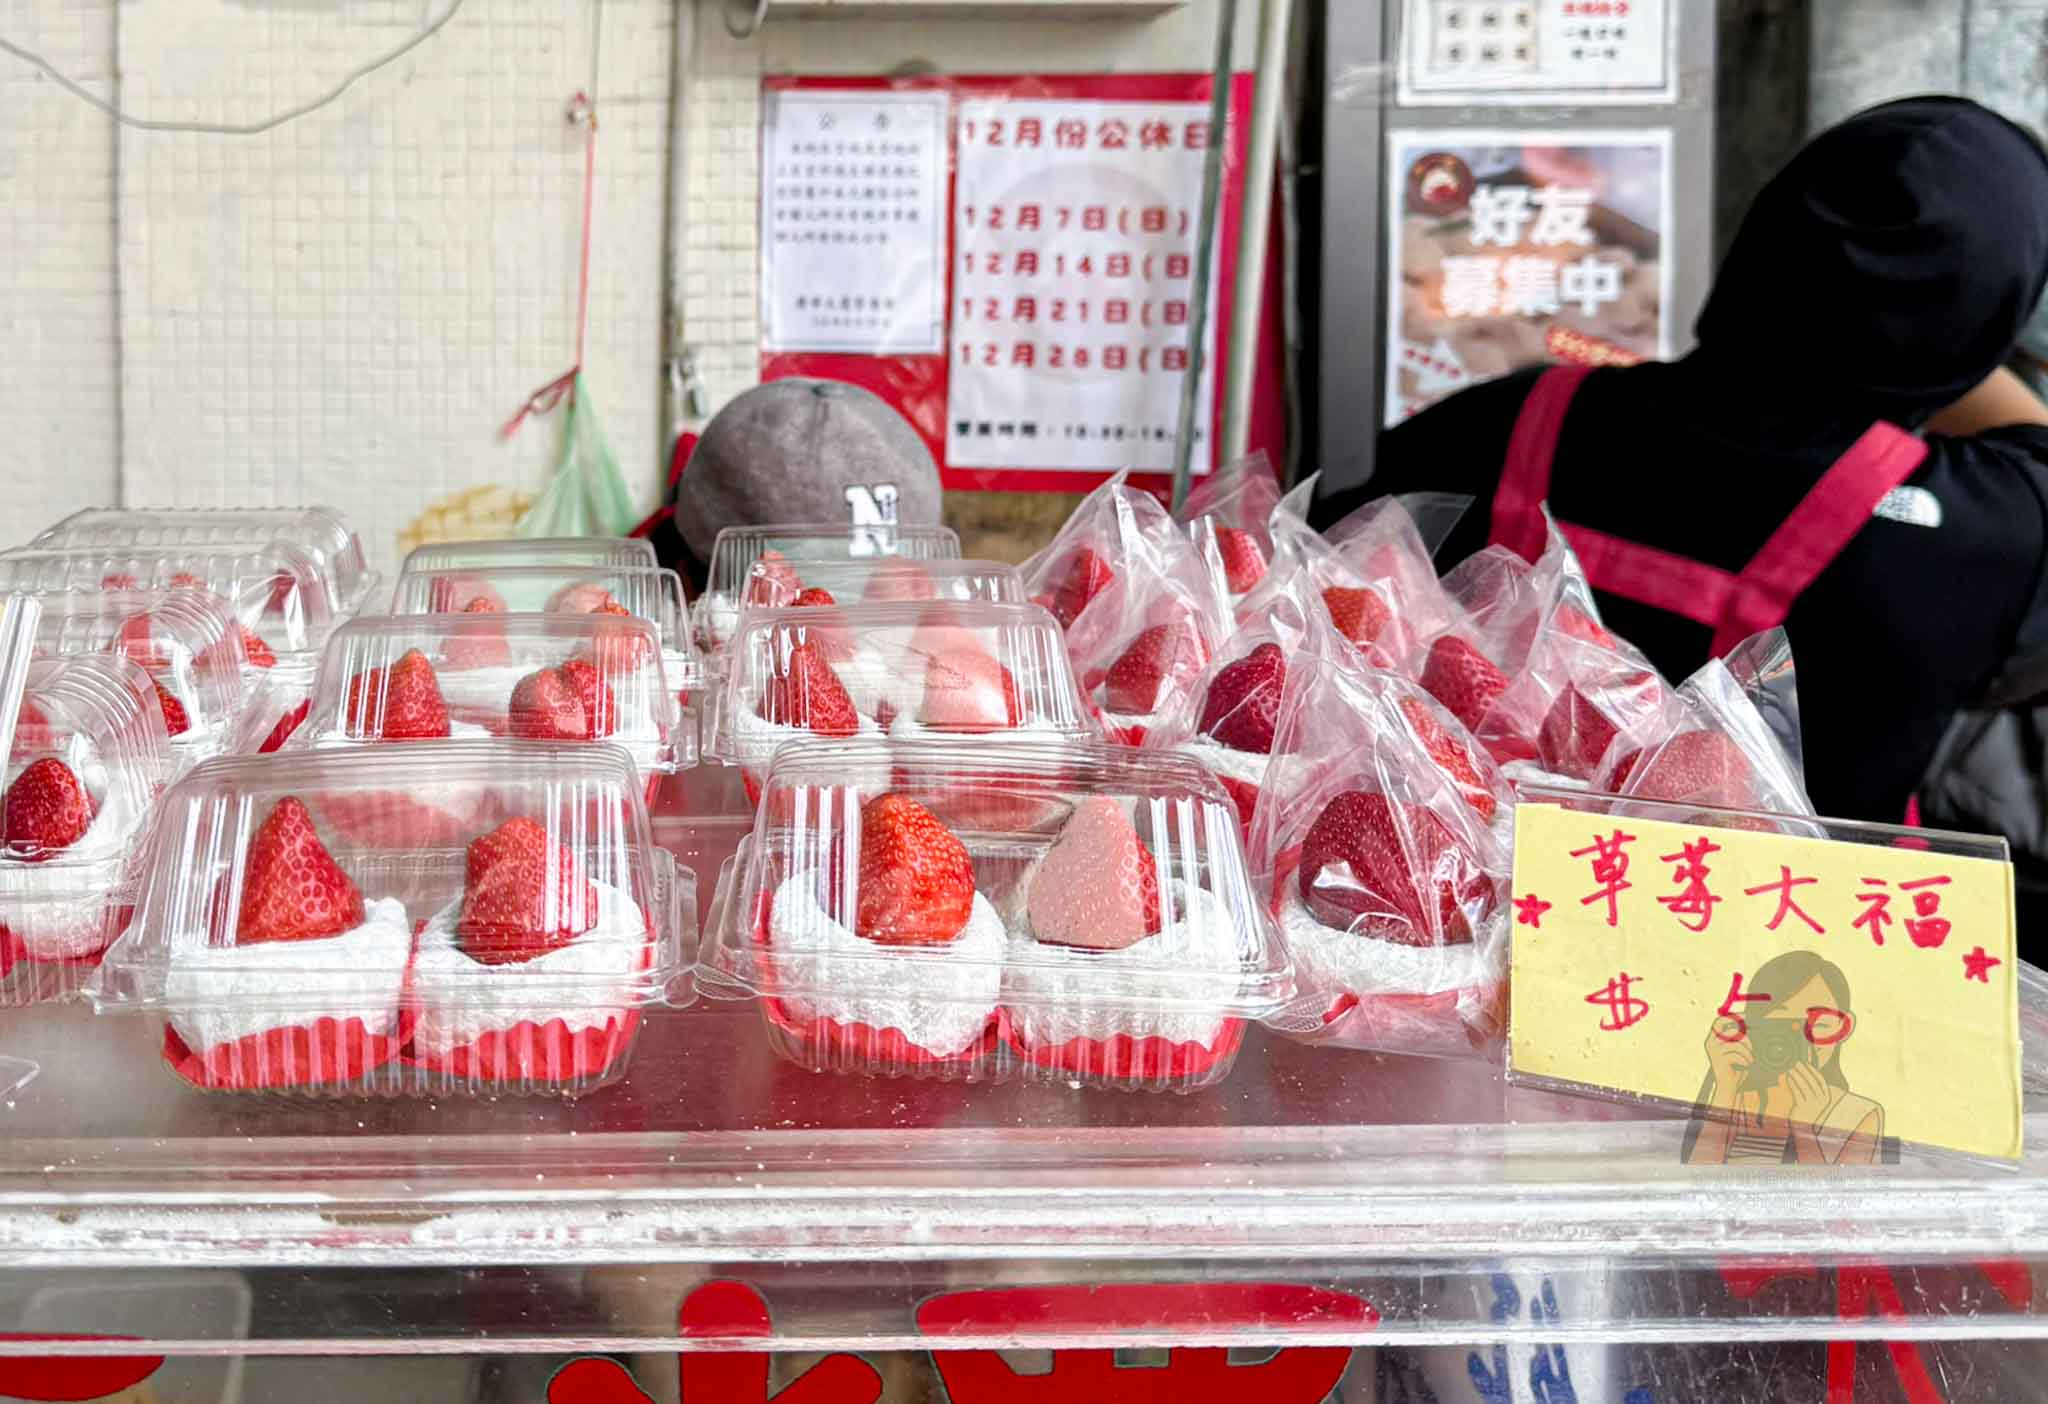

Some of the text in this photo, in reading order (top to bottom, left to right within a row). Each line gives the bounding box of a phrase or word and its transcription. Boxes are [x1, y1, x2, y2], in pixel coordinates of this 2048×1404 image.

[965, 117, 1211, 149] 12月份公休日
[1470, 185, 1596, 246] 好友
[963, 250, 1190, 282] 12月14日(日
[962, 296, 1187, 327] 12月21日(日
[1570, 830, 1952, 949] 草莓大福
